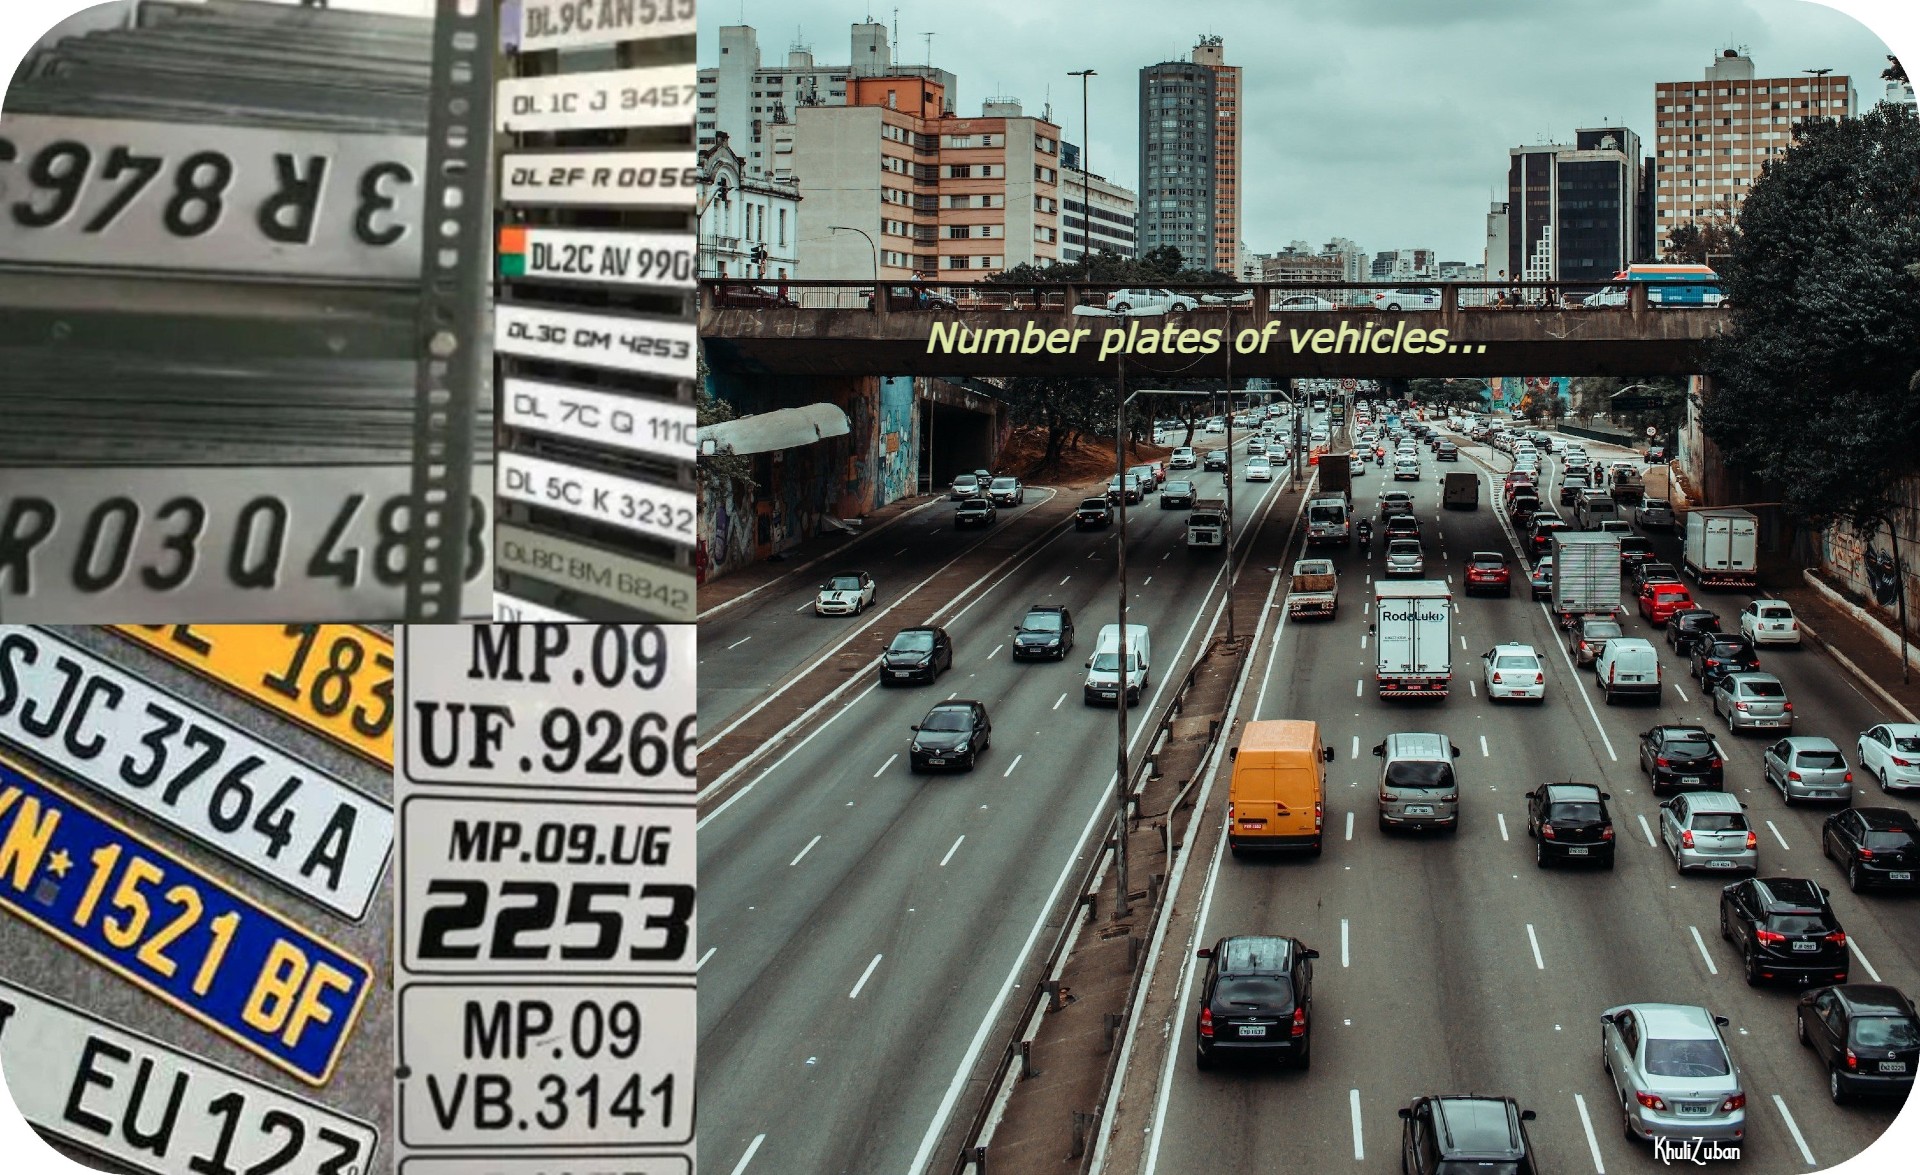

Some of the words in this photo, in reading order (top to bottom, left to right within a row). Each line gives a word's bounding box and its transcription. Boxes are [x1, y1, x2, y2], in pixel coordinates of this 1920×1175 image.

[512, 95, 541, 115] DL
[589, 90, 608, 111] J
[620, 85, 696, 110] 3457
[511, 167, 542, 187] DL
[548, 167, 586, 187] 2F
[591, 167, 613, 188] R
[531, 242, 595, 274] DL2C
[600, 246, 632, 276] AV
[507, 321, 567, 345] DL3C
[619, 333, 691, 360] 4253
[513, 393, 549, 419] DL
[559, 400, 601, 428] 7C
[610, 410, 634, 435] Q
[506, 467, 536, 495] DL
[546, 476, 582, 506] 5C
[593, 487, 610, 514] K
[619, 493, 695, 535] 3232
[467, 624, 668, 690] MP.09
[0, 633, 125, 760] SJC
[119, 702, 304, 860] 3764
[300, 802, 358, 892] A
[449, 819, 672, 867] MP.09.UG
[72, 842, 242, 997] 1521
[242, 938, 354, 1049] BF
[417, 880, 697, 961] 2253
[464, 1000, 641, 1060] MP.09
[64, 1035, 190, 1158] EU
[426, 1073, 674, 1130] VB.3141
